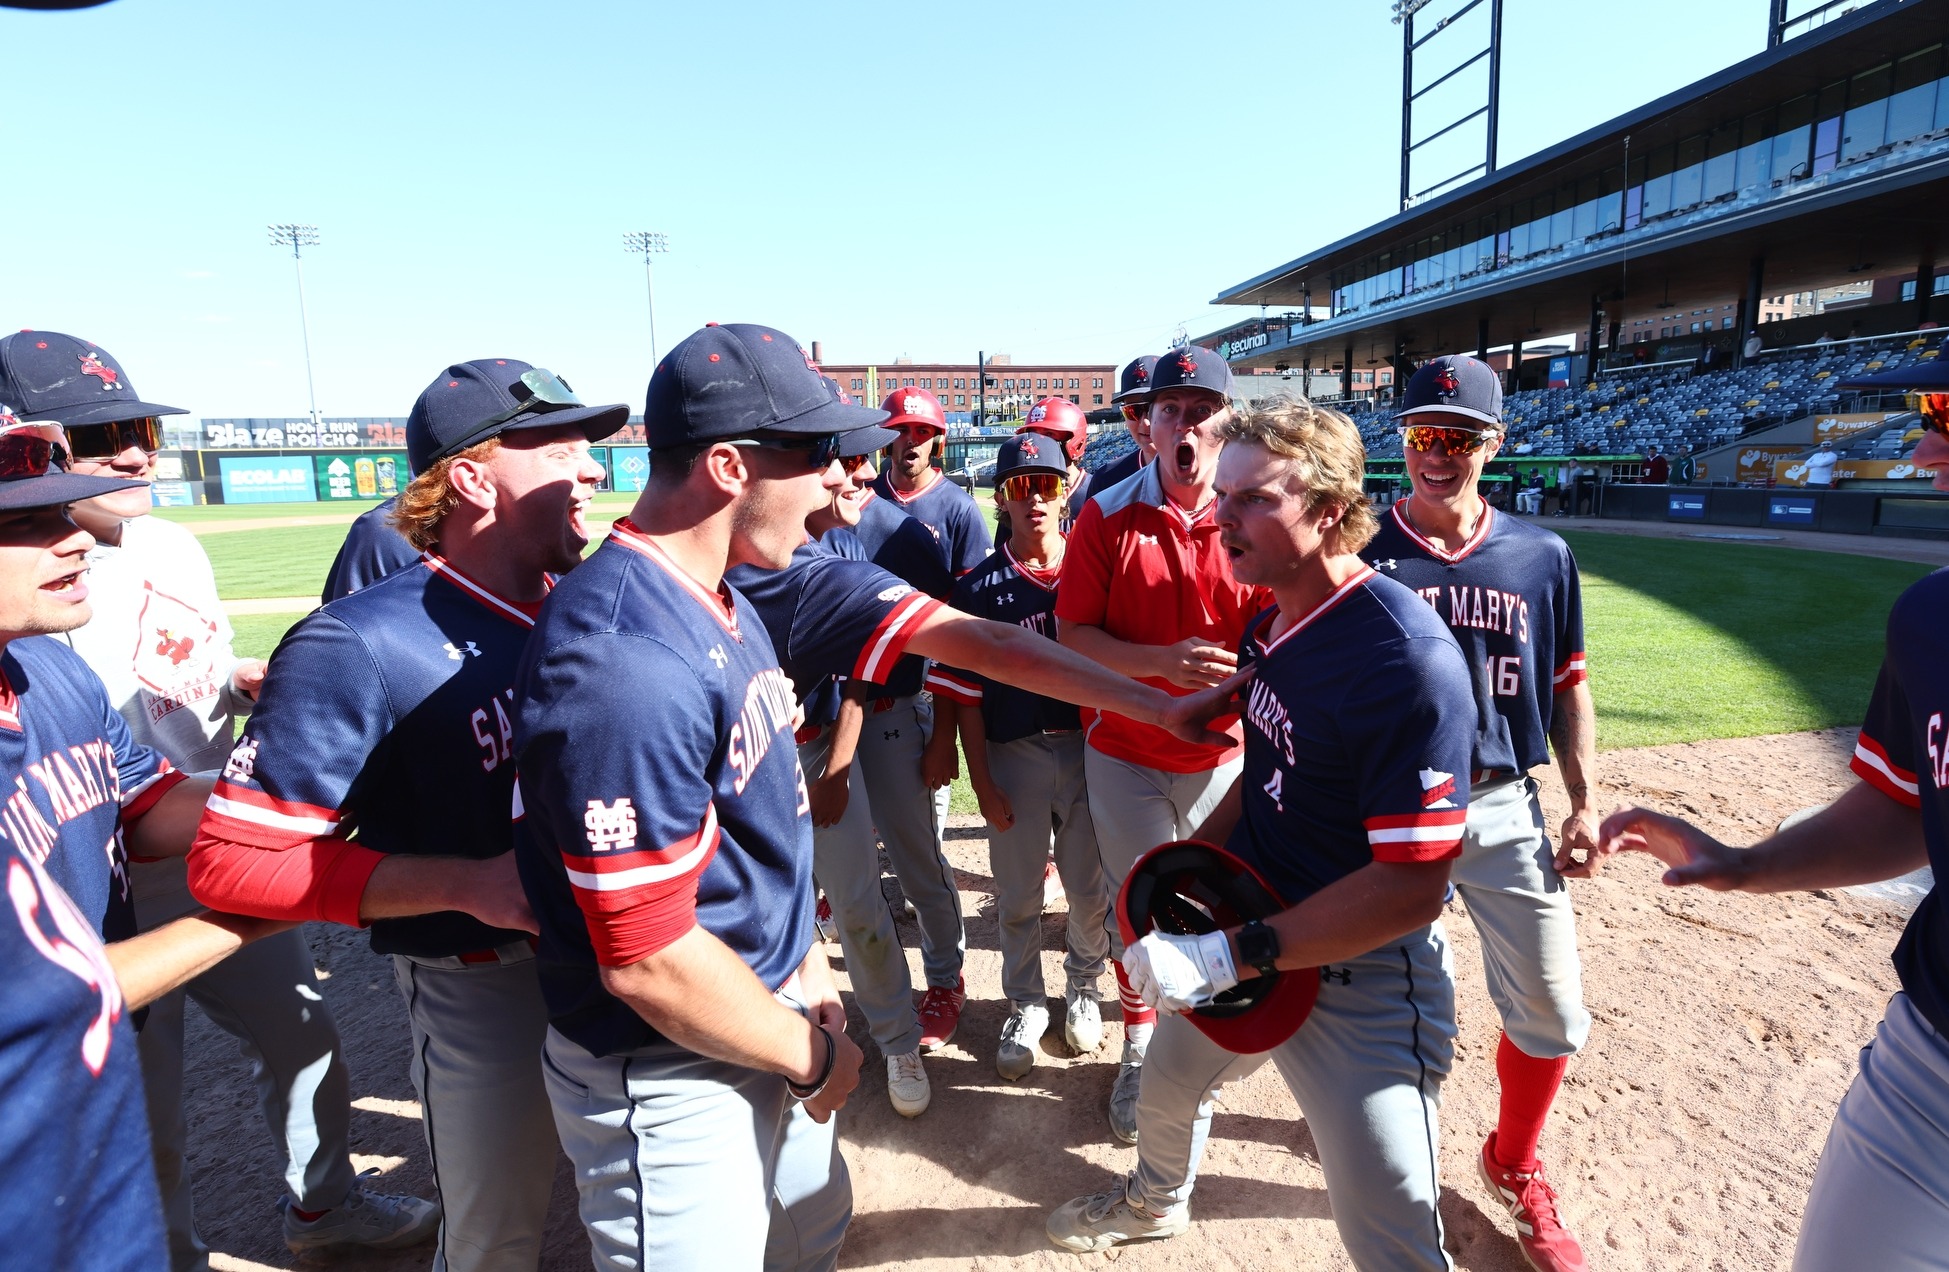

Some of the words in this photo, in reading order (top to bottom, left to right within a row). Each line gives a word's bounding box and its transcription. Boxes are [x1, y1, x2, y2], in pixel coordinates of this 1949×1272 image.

[1231, 333, 1267, 354] securian
[329, 423, 359, 434] RUN
[367, 423, 408, 445] Bla
[991, 427, 1018, 435] DESTINA
[1837, 421, 1877, 431] Bywater
[229, 469, 305, 485] ECOLAB
[1832, 469, 1857, 478] ater
[1449, 585, 1528, 644] MARY'S
[1486, 655, 1520, 696] 16
[150, 681, 219, 722] CARDINA
[471, 688, 515, 773] SA
[27, 737, 121, 826] MARY'S
[1263, 767, 1284, 812] 4
